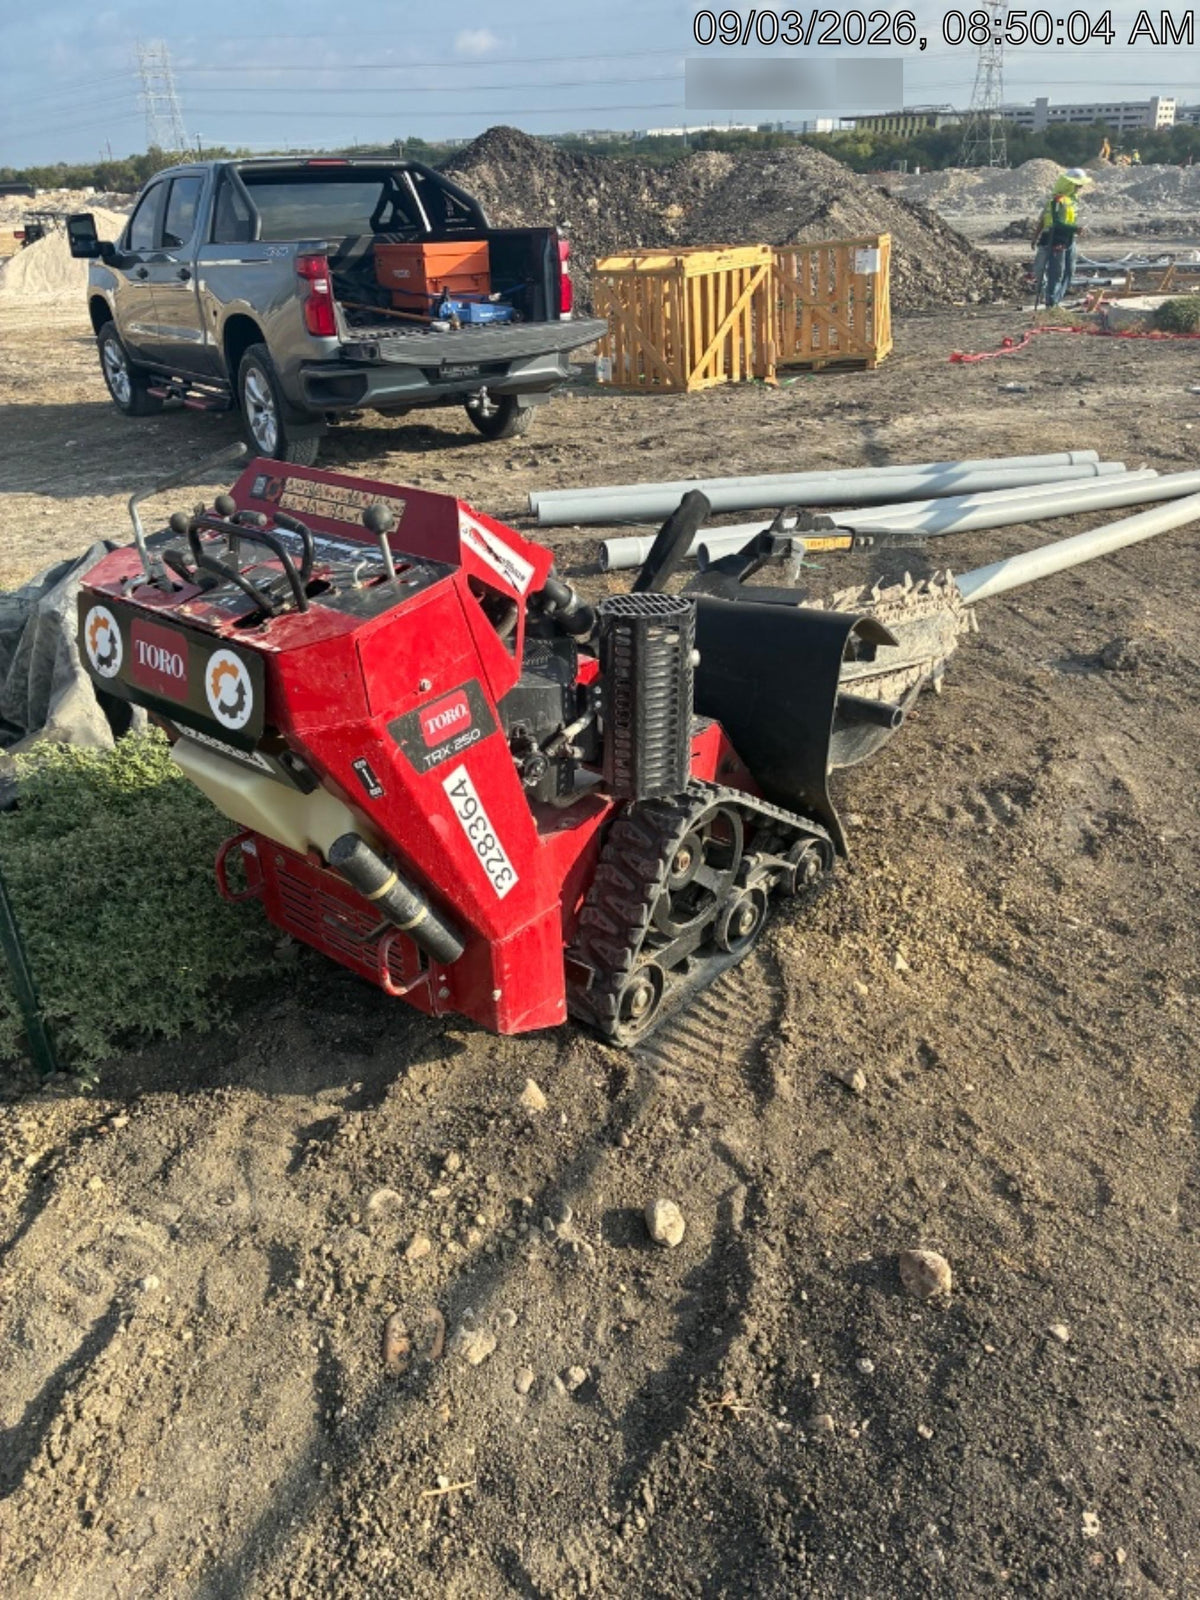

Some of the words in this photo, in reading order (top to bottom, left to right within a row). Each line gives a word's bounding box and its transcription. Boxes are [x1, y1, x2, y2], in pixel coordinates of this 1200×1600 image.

[136, 640, 185, 679] TORO
[425, 704, 466, 734] TORO
[450, 778, 512, 890] 328364
